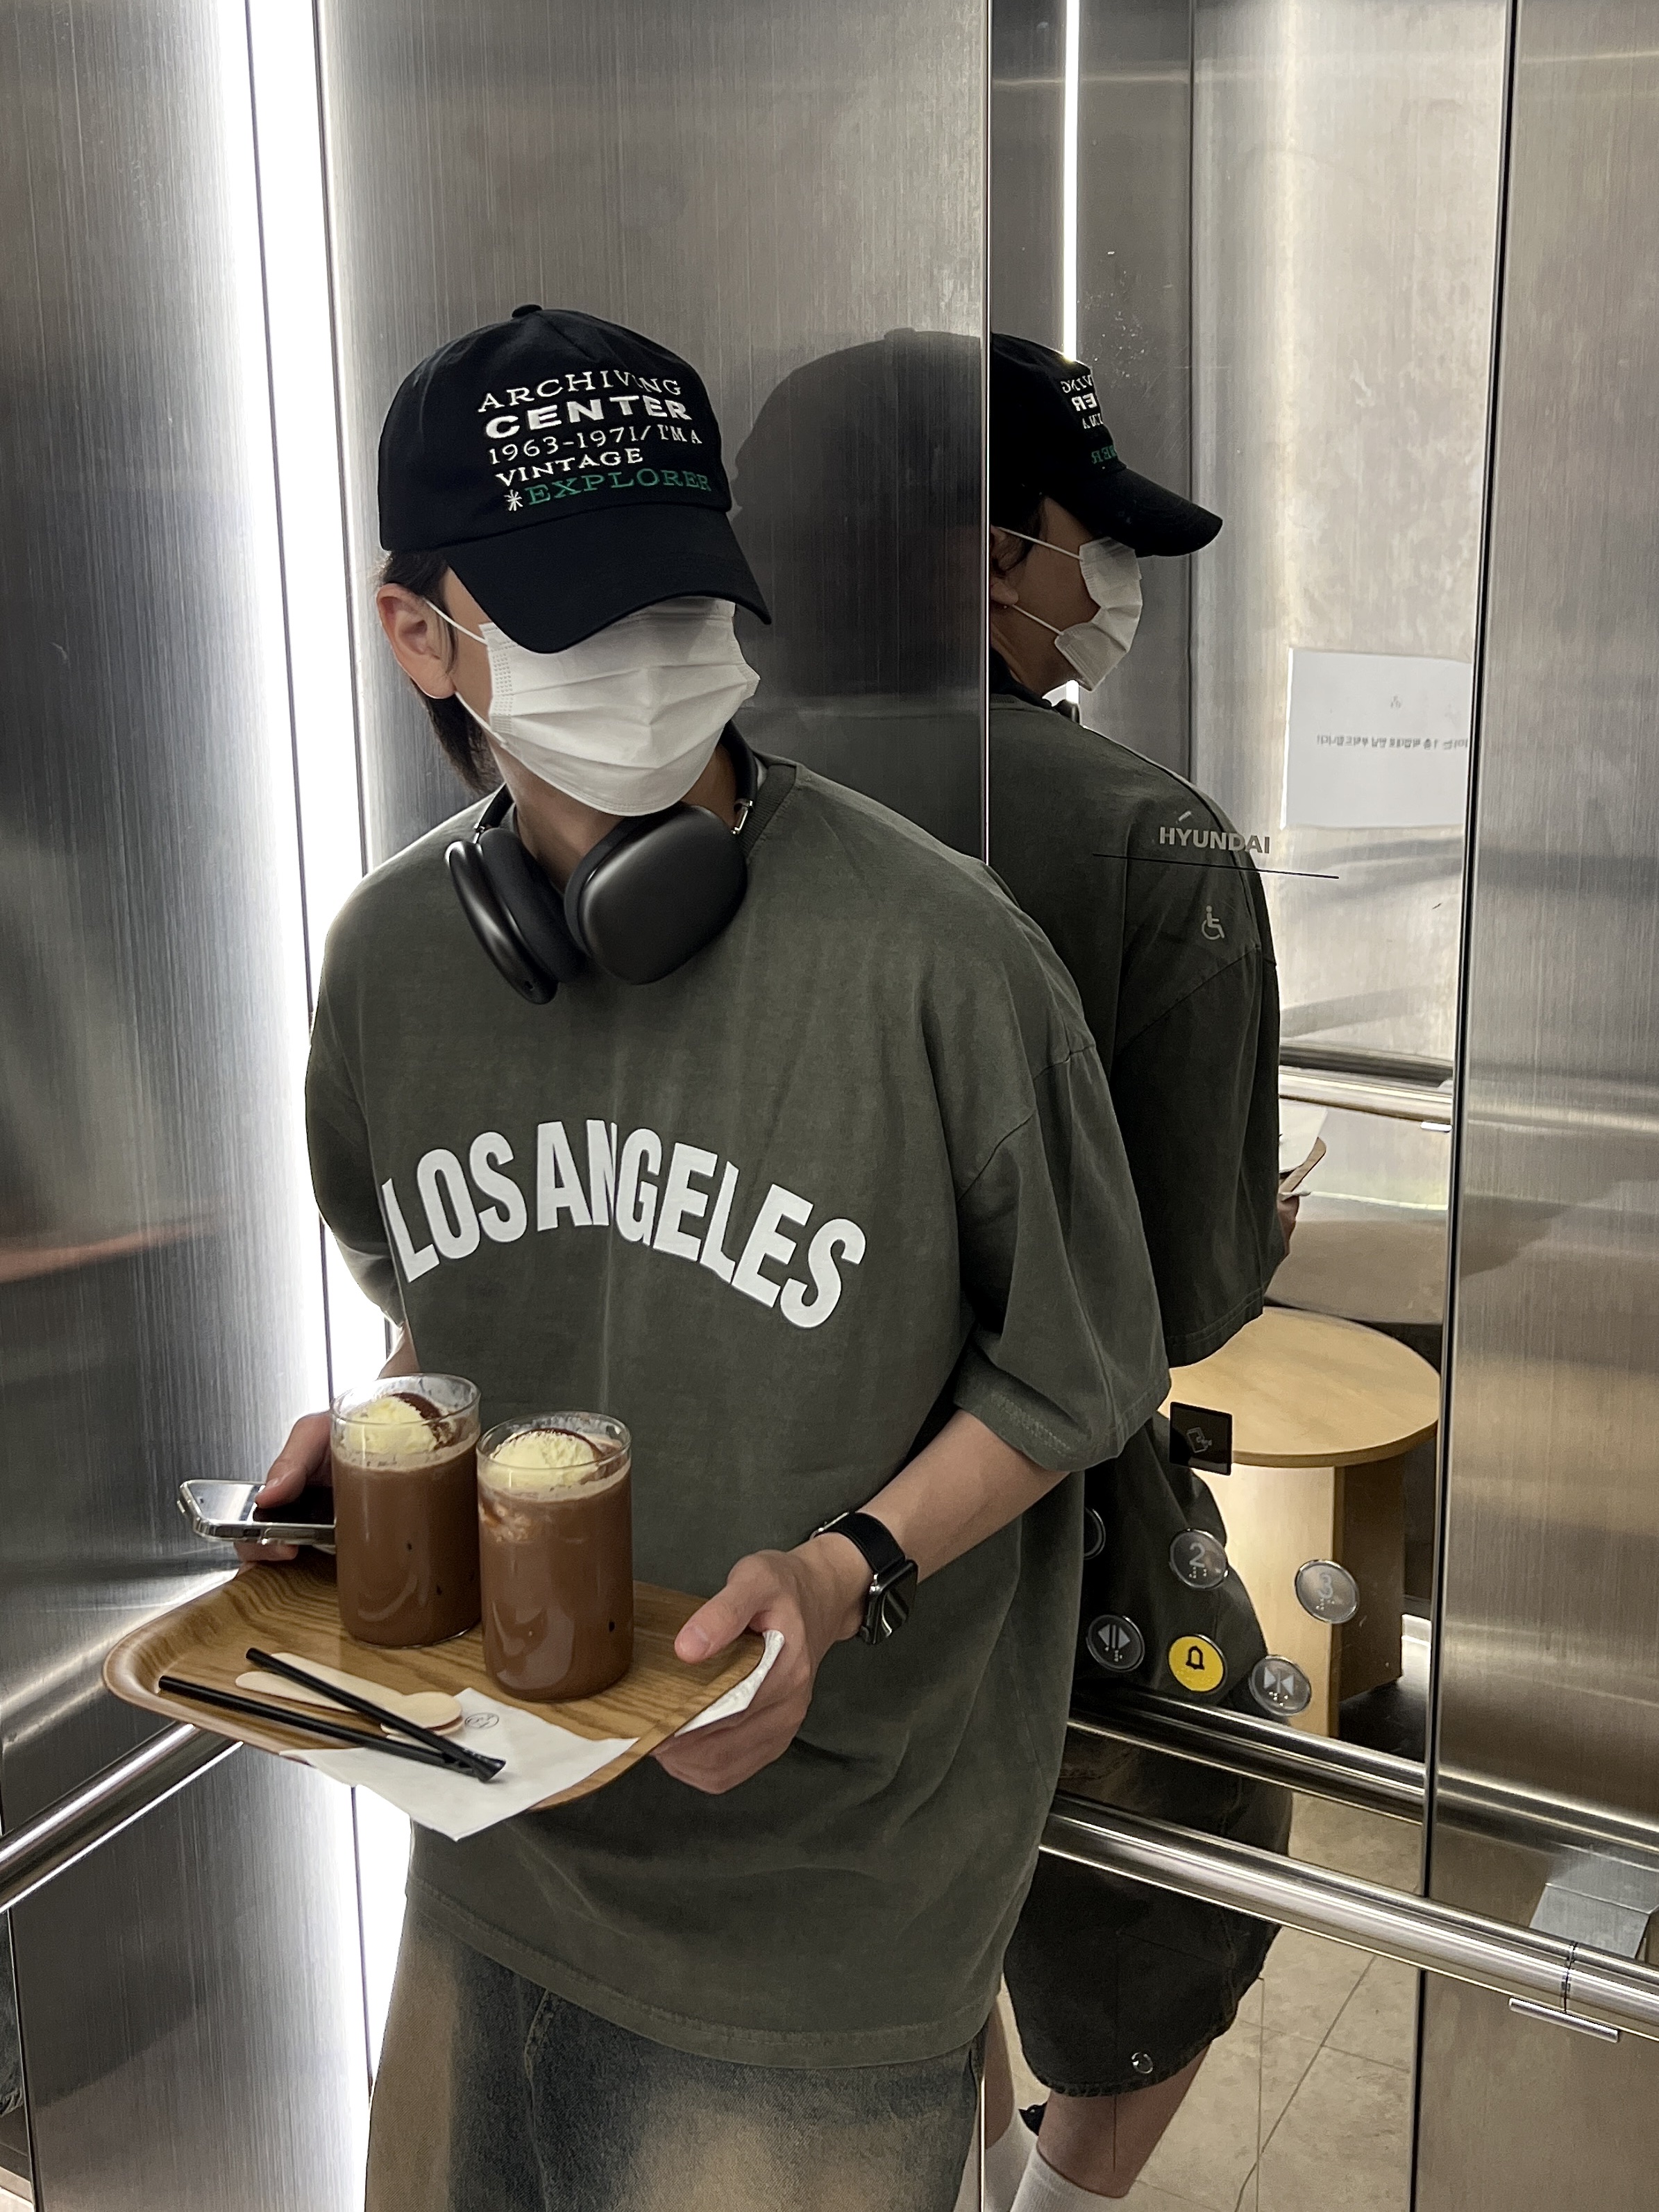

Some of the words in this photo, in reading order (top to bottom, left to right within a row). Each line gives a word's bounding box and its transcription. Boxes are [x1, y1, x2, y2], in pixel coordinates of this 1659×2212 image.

[478, 369, 682, 414] ARCHIVING
[485, 395, 692, 439] CENTER
[488, 423, 652, 464] 1963-1971/
[657, 423, 688, 443] I'M
[691, 429, 703, 444] A
[494, 447, 643, 487] VINTAGE
[1159, 826, 1270, 854] HYUNDAI
[382, 1131, 528, 1283] LOS
[537, 1119, 867, 1329] ANGELES
[1189, 1542, 1206, 1569] 2
[1319, 1571, 1334, 1600] 3
